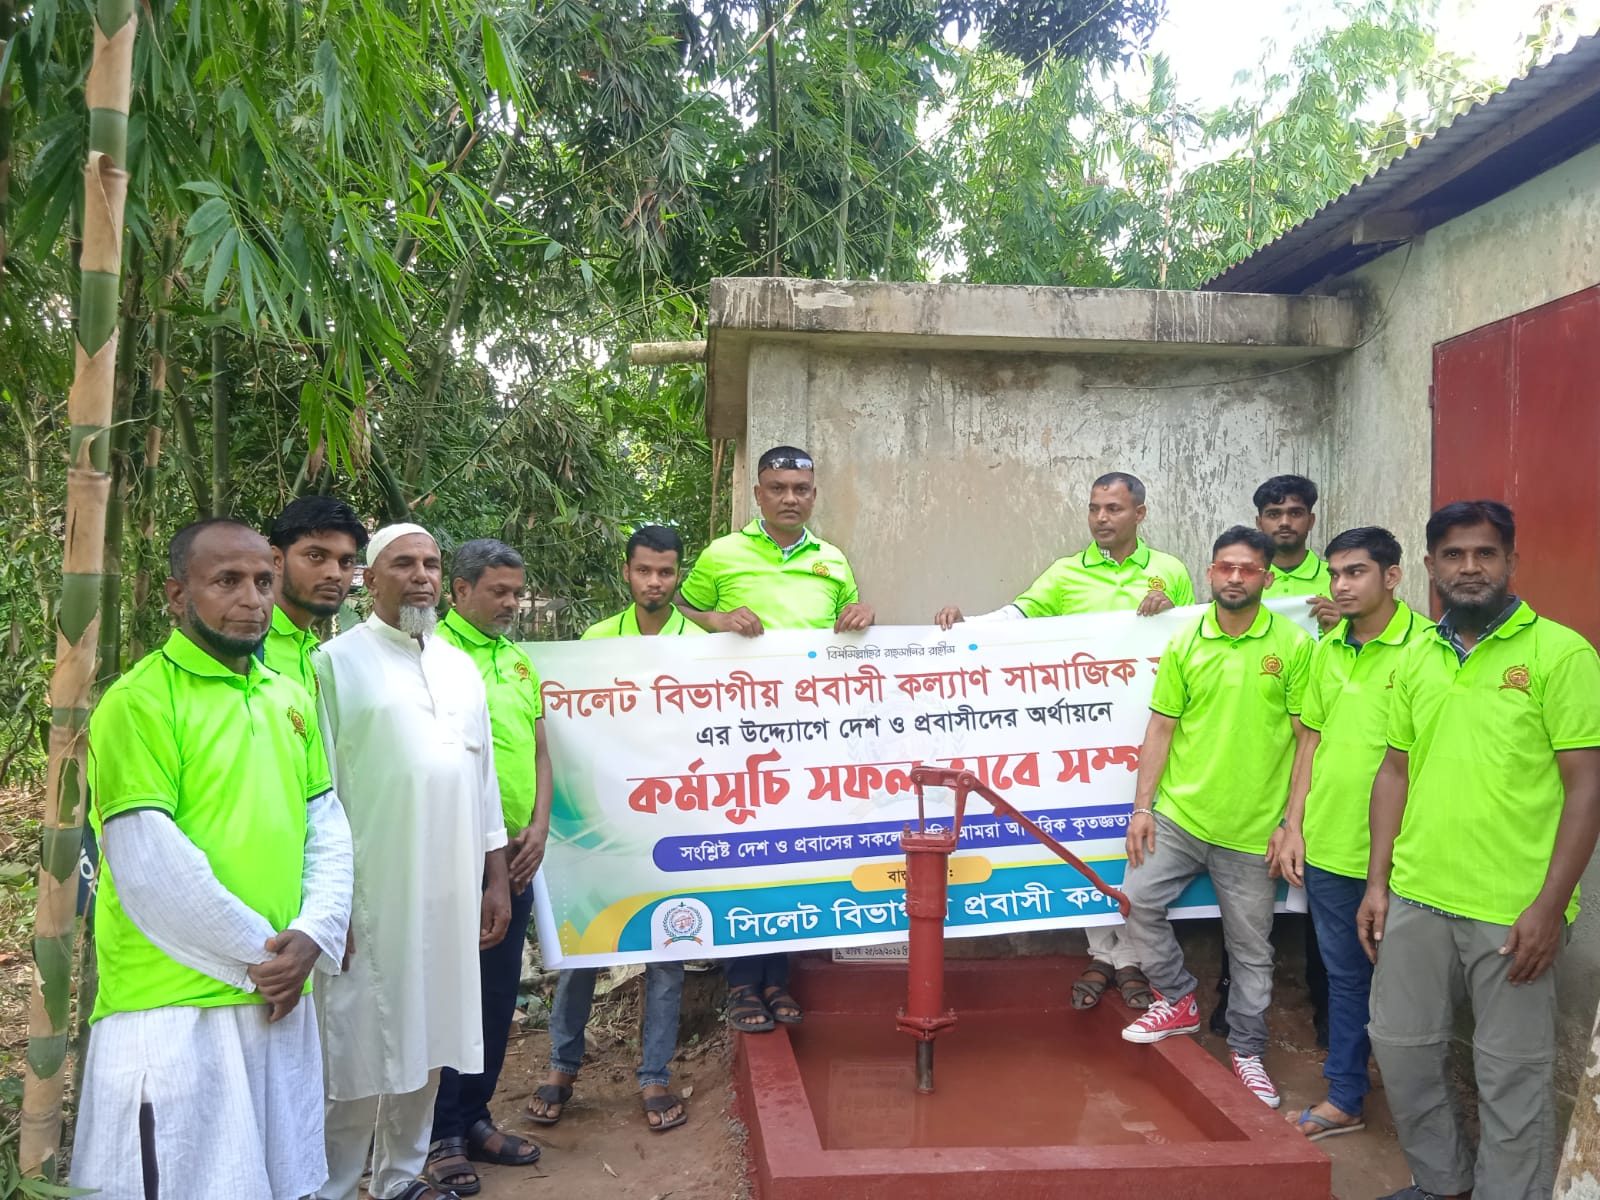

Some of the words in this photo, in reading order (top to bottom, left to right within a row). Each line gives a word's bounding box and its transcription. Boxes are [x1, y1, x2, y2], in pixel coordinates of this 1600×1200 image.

[540, 677, 642, 720] সিলেট
[650, 670, 784, 714] বিভাগীয়
[795, 664, 887, 708] প্রবাসী
[895, 665, 991, 701] কল্যাণ
[1001, 652, 1138, 693] সামাজিক
[696, 725, 732, 747] এর
[839, 715, 881, 738] দেশ
[889, 715, 905, 734] ও
[914, 705, 1019, 735] প্রবাসীদের
[1026, 697, 1113, 723] অর্থায়নে
[804, 760, 924, 801] সফল
[680, 840, 731, 862] সংশ্লিষ্ট
[738, 840, 769, 858] দেশ
[775, 840, 788, 853] ও
[795, 835, 853, 853] প্রবাসের
[724, 903, 822, 939] সিলেট
[964, 882, 1055, 919] প্রবাসী
